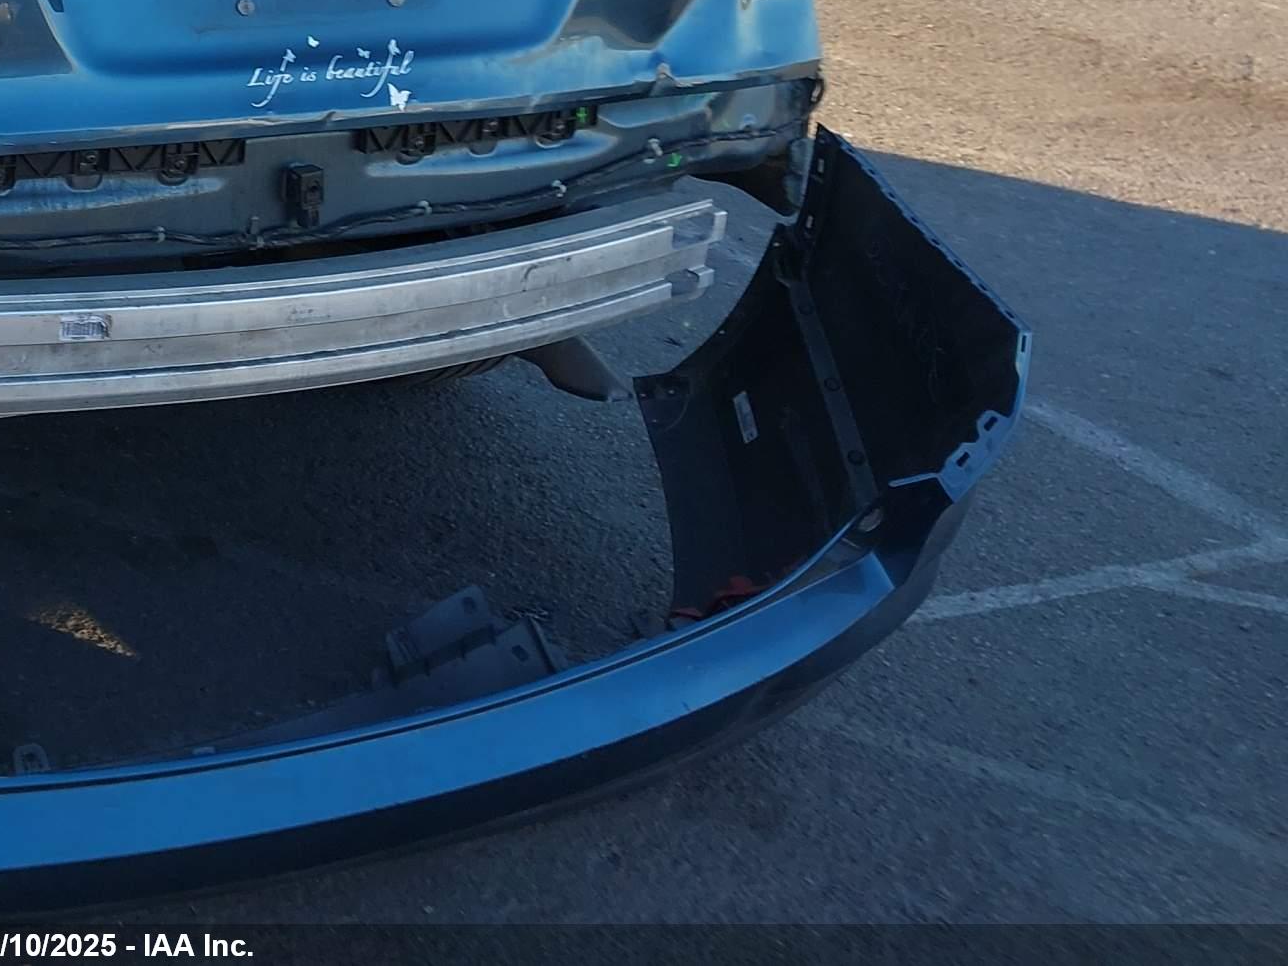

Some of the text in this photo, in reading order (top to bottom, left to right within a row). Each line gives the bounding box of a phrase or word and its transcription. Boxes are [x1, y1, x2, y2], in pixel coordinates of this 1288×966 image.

[247, 38, 415, 108] Life is beautiful
